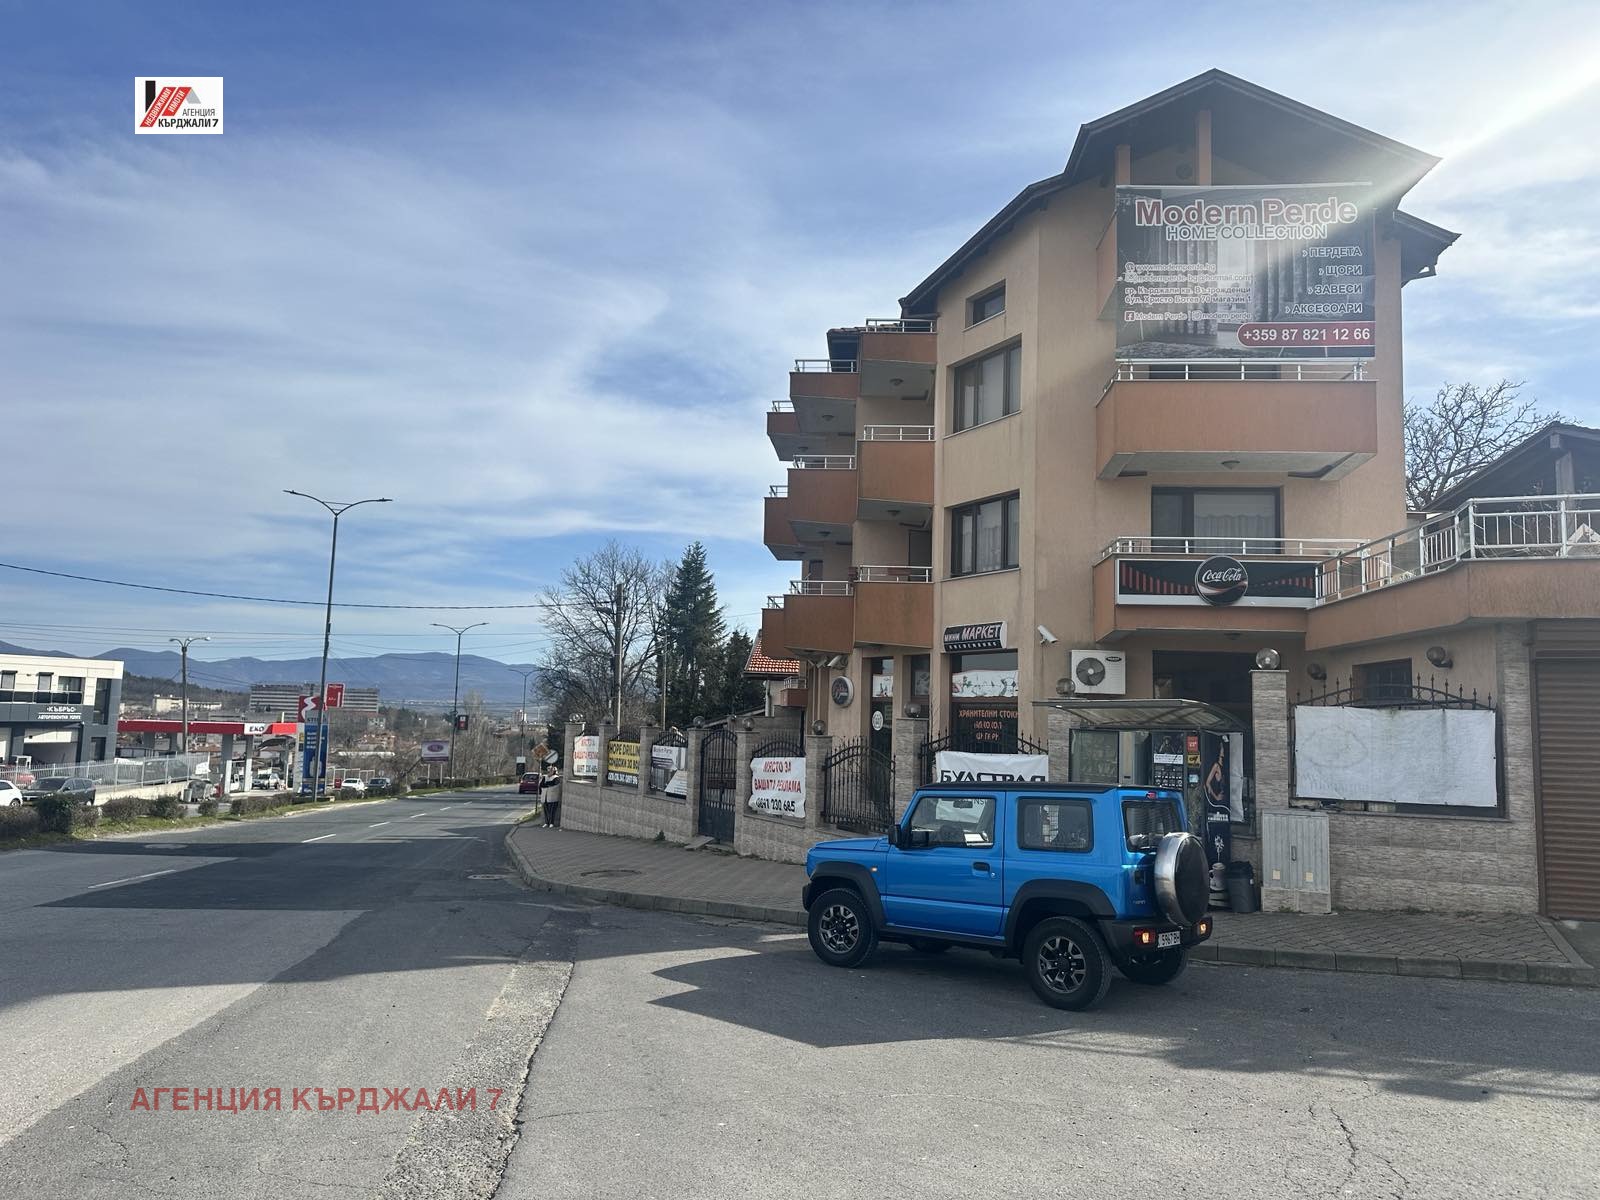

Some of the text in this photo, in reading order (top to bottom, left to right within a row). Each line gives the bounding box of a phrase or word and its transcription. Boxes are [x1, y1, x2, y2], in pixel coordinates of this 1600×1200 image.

[1136, 197, 1358, 226] Modern Perde
[1166, 225, 1328, 241] HOME COLLECTION
[1310, 247, 1362, 258] ПЕРДЕТА
[1326, 266, 1362, 276] ЩОРИ
[1315, 284, 1362, 295] ЗАВЕСИ
[1144, 296, 1173, 304] Христо
[1292, 303, 1362, 314] АКСЕСОАРИ
[1244, 328, 1370, 341] +359 87 821 12 66
[1202, 567, 1242, 583] Coca-Cola
[962, 624, 1000, 640] МАРКЕТ
[771, 799, 782, 810] 230
[783, 800, 796, 812] 685
